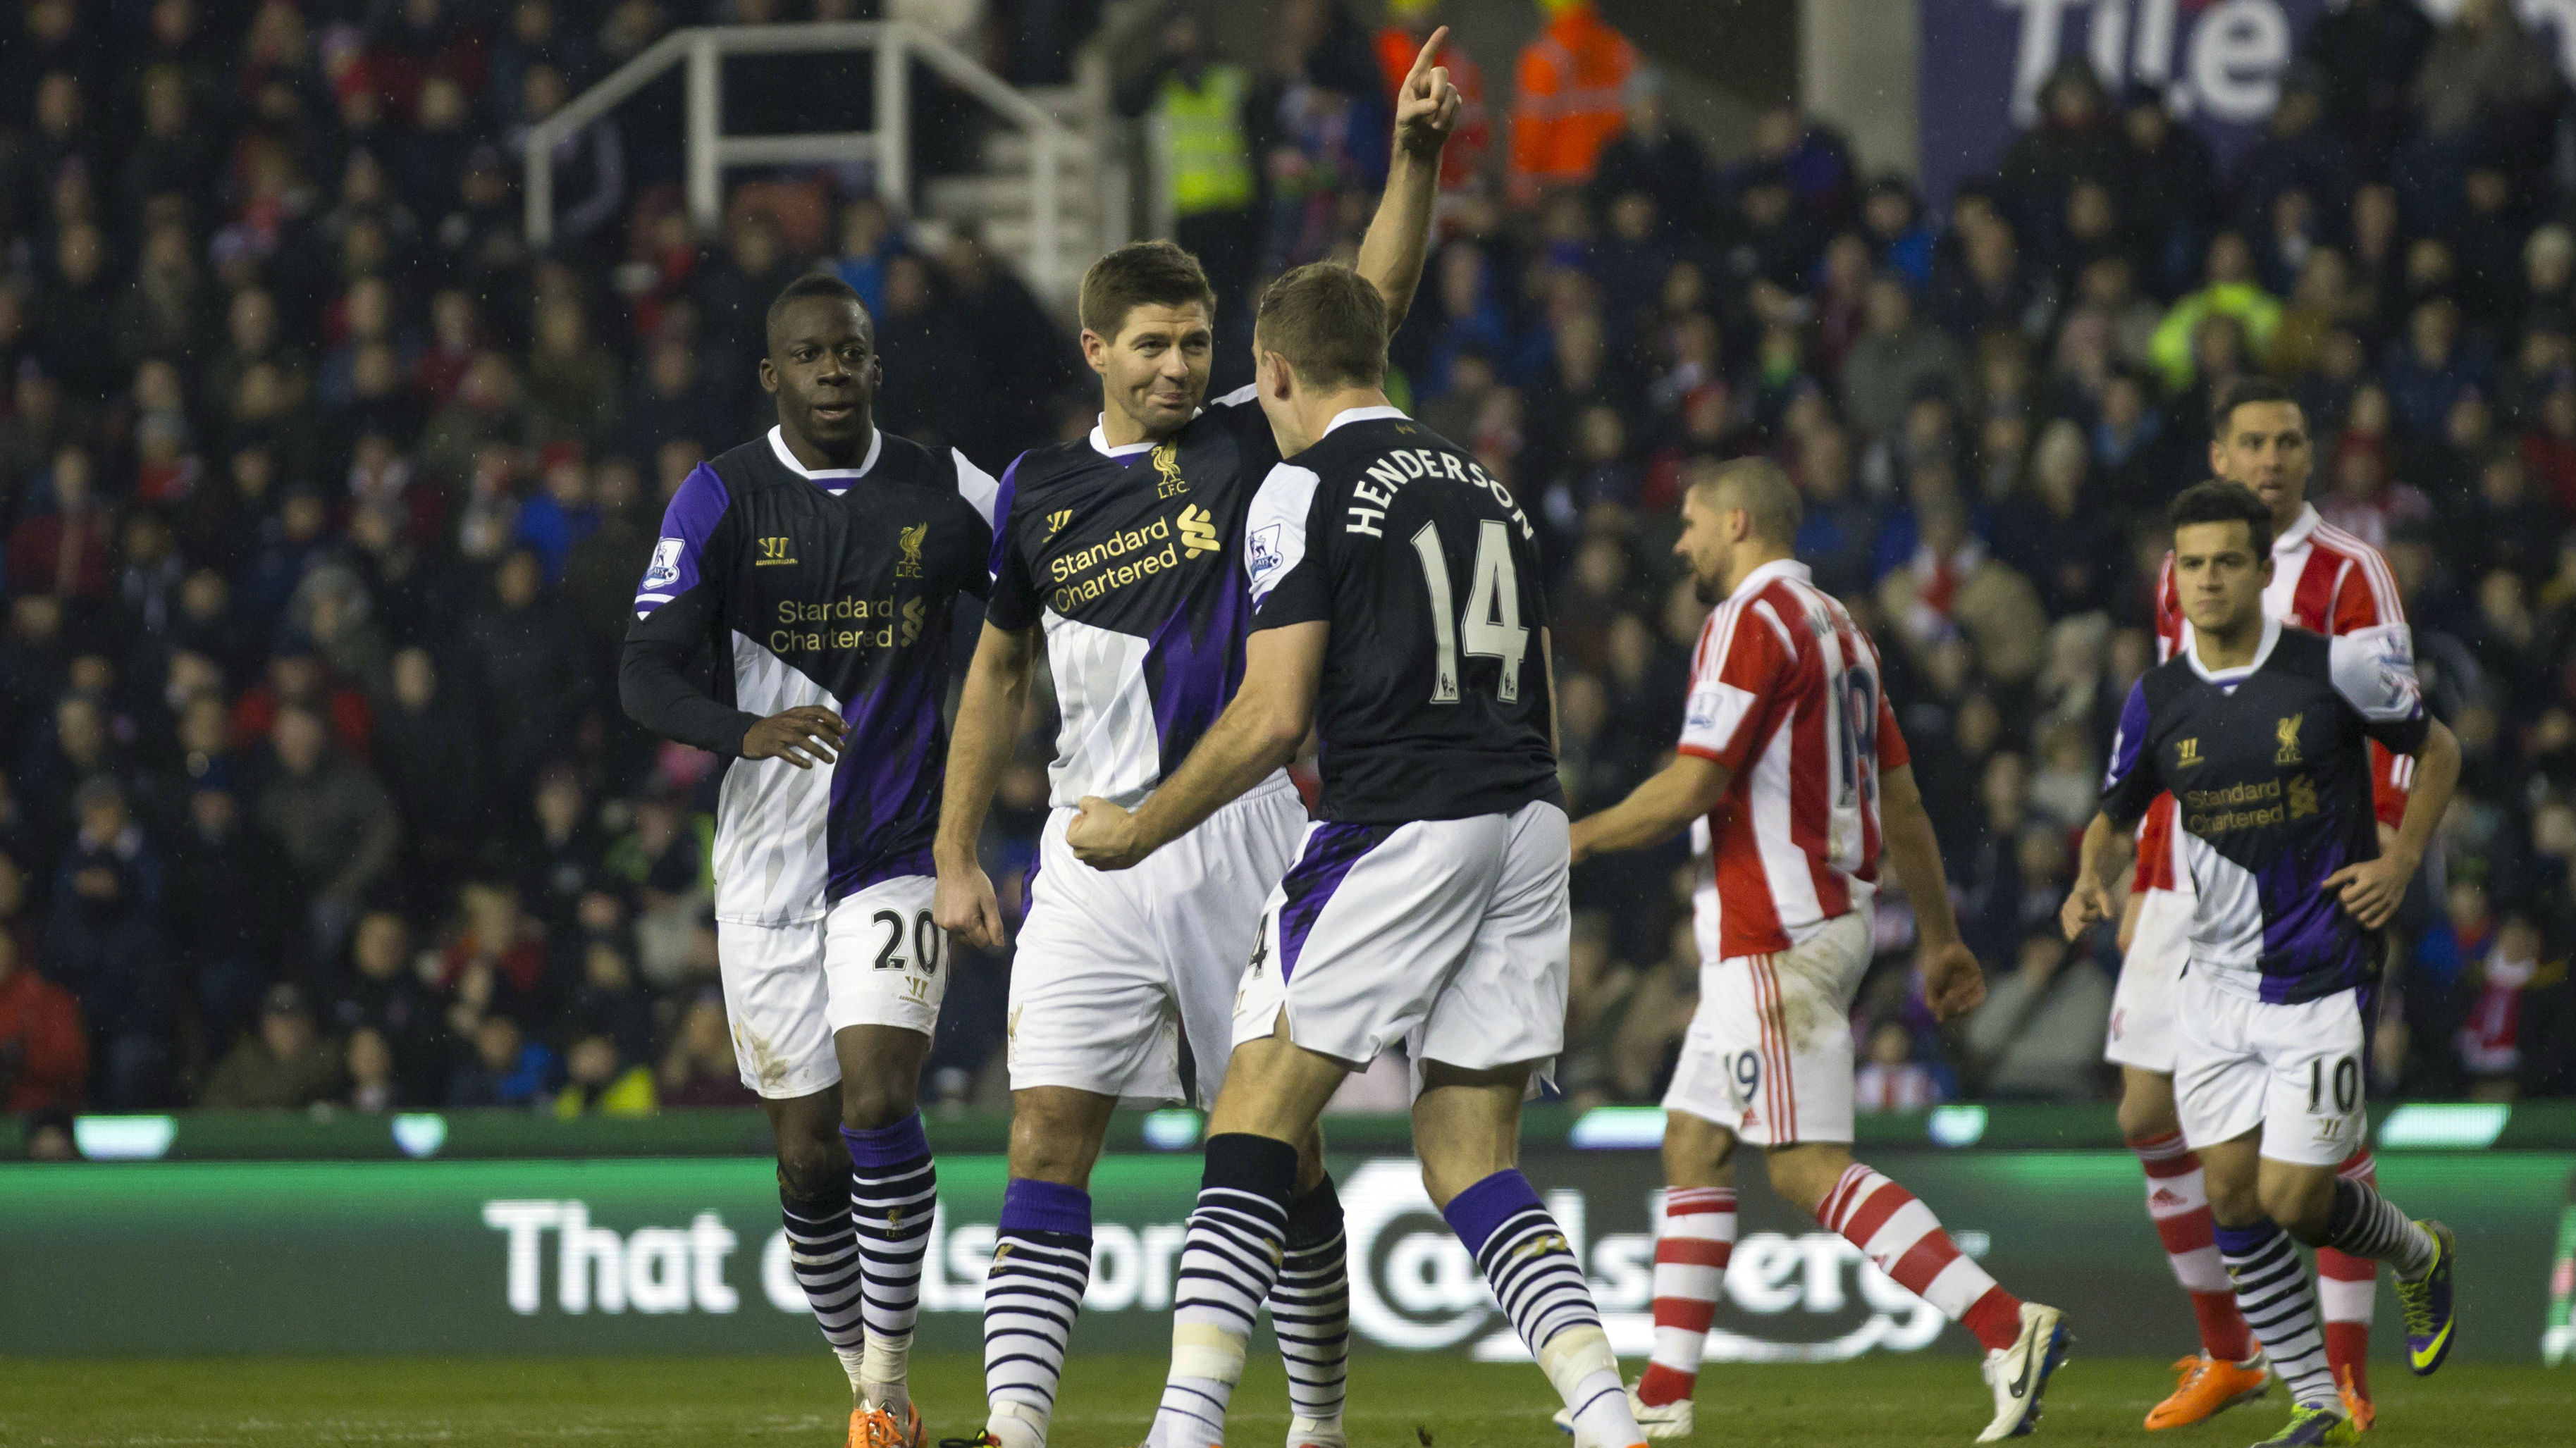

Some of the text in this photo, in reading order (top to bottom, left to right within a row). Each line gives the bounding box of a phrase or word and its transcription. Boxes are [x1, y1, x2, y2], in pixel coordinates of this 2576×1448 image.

[1346, 449, 1534, 538] HENDERSON
[1051, 516, 1170, 582] Standard
[1055, 543, 1178, 612] Chartered
[770, 624, 892, 653] Chartered
[778, 595, 894, 624] Standard
[1410, 519, 1529, 704] 14
[2187, 778, 2281, 809] Standard
[2189, 803, 2284, 834] Chartered
[871, 908, 940, 977] 20
[2306, 1055, 2358, 1114] 10
[481, 1200, 739, 1313] That
